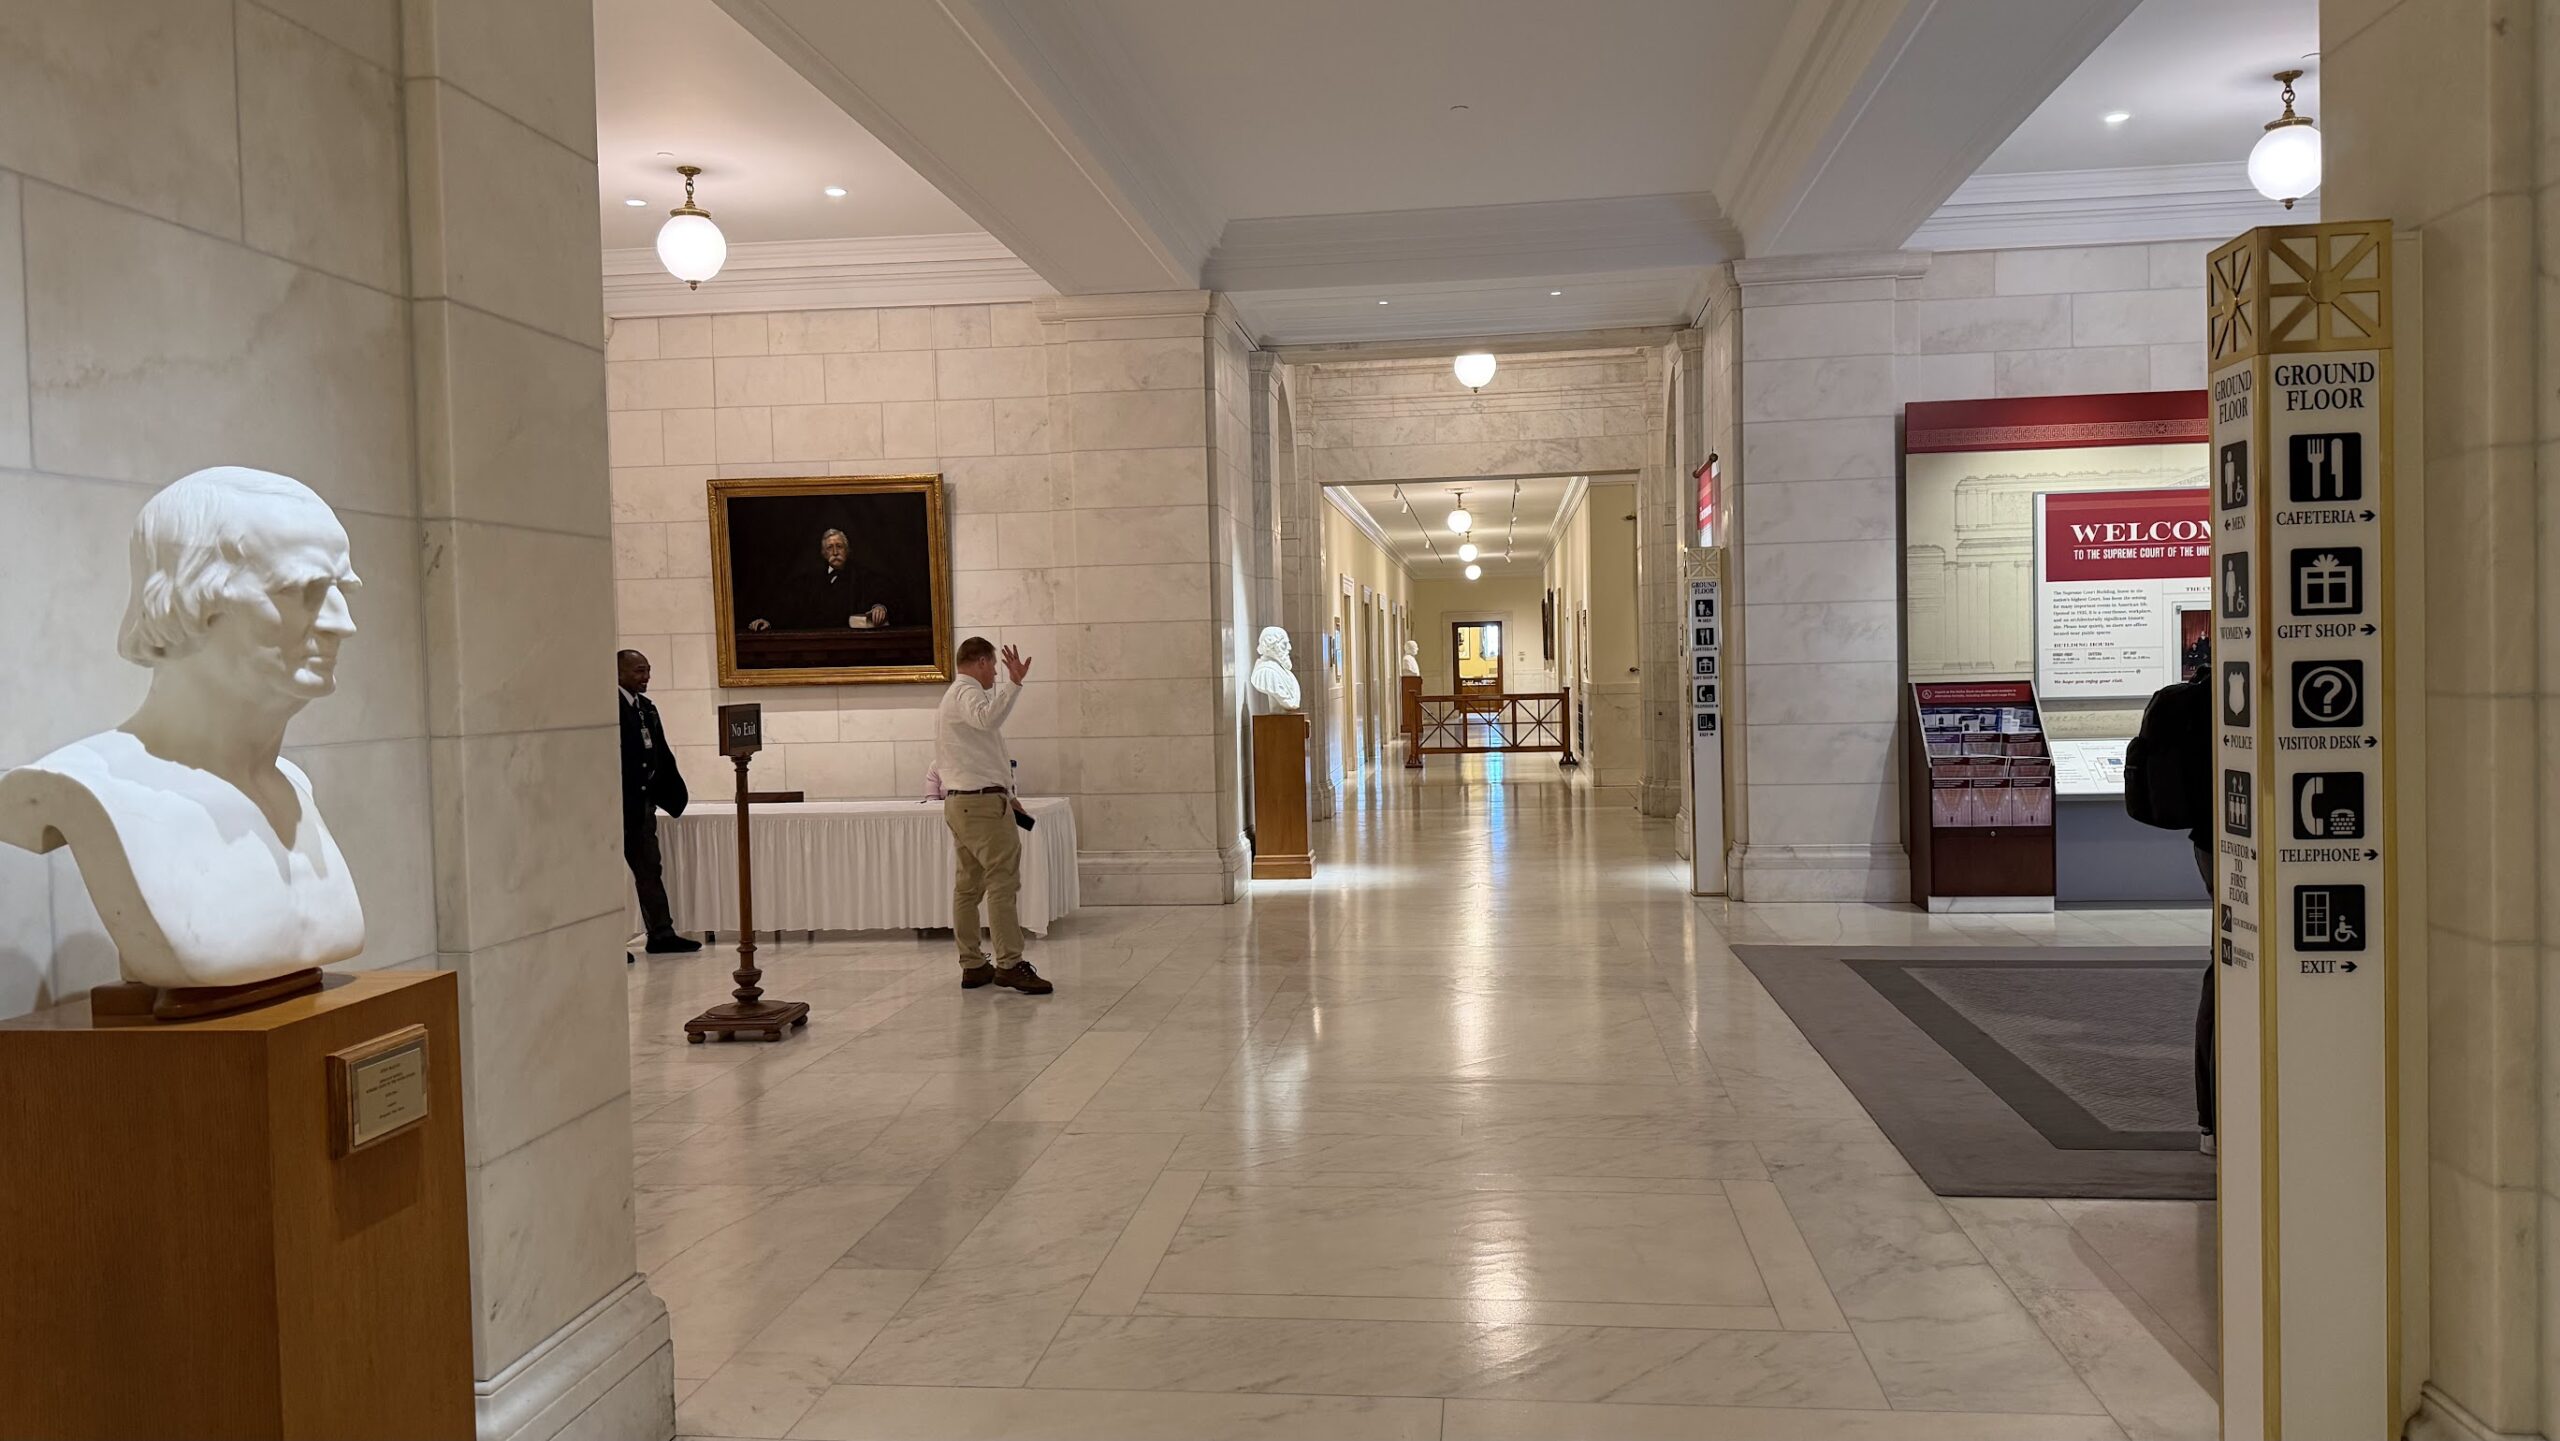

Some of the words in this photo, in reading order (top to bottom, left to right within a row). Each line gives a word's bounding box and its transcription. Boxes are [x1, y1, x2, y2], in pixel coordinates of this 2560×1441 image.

[2275, 362, 2375, 386] GROUND
[2214, 370, 2252, 402] GROUND
[2286, 387, 2365, 411] FLOOR
[2219, 396, 2248, 424] FLOOR
[2232, 515, 2246, 530] MEN
[2276, 510, 2356, 525] CAFETERIA
[2074, 550, 2084, 560] TO
[2087, 548, 2100, 560] THE
[2103, 547, 2138, 560] SUPREME
[2140, 546, 2164, 558] COURT
[2168, 546, 2177, 558] OF
[2180, 546, 2194, 556] THE
[2220, 626, 2244, 640] WOMEN
[2278, 624, 2312, 638] GIFT
[2315, 624, 2356, 638] SHOP
[731, 722, 741, 736] No
[743, 721, 756, 736] Exit
[2230, 735, 2252, 749] POLICE
[2278, 736, 2328, 750] VISITOR
[2330, 735, 2361, 749] DESK
[2220, 840, 2249, 859] ELEVATOR
[2280, 848, 2360, 862] TELEPHONE
[2234, 858, 2242, 872] TO
[2231, 872, 2247, 889] FIRST
[2229, 887, 2249, 905] FLOOR
[2300, 960, 2336, 974] EXIT
